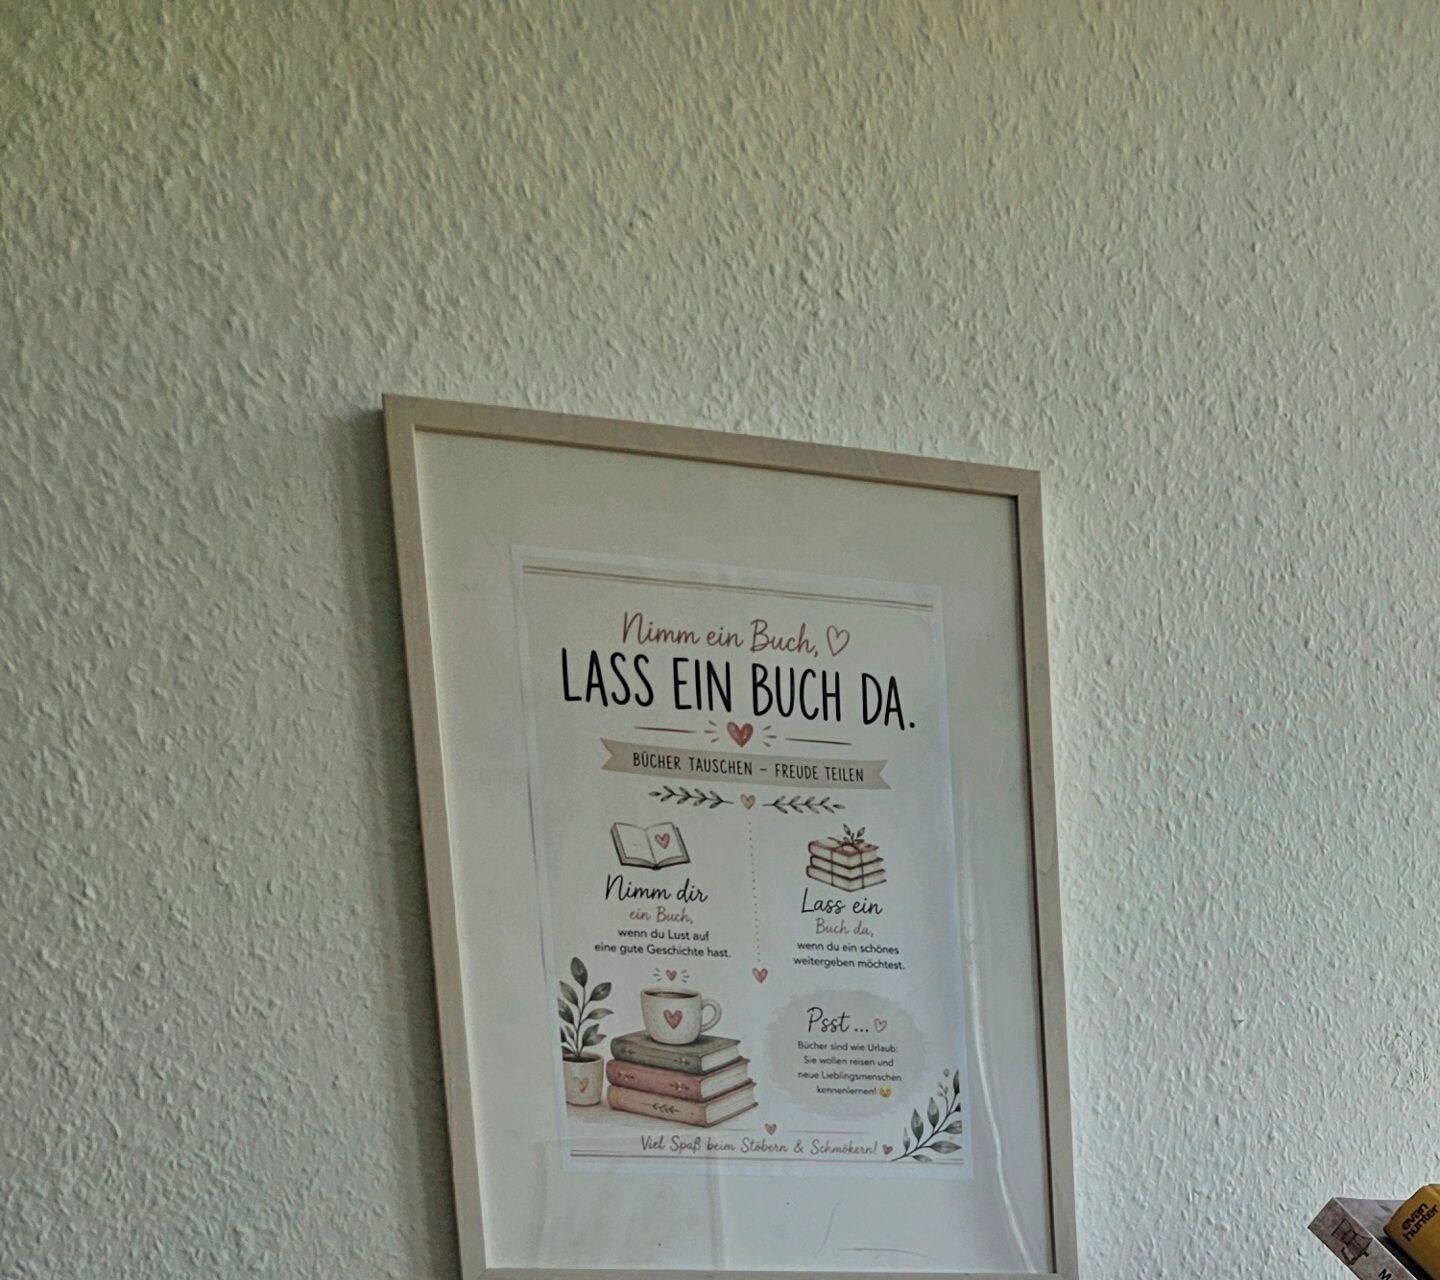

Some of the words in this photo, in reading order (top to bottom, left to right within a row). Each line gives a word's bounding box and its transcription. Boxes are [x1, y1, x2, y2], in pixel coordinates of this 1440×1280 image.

[623, 612, 700, 645] Nimm
[707, 626, 744, 648] ein
[750, 619, 818, 657] Buch,
[561, 648, 654, 707] LASS
[674, 657, 732, 713] EIN
[753, 663, 840, 722] BUCH
[861, 672, 915, 730] DA.
[633, 752, 681, 770] BÜCHER
[688, 757, 753, 775] TAUSCHEN
[775, 764, 818, 780] FREUDE
[824, 767, 863, 782] TEILEN
[605, 874, 670, 901] Nimm
[677, 878, 708, 903] dir
[801, 887, 845, 914] Lass
[853, 898, 883, 914] ein
[630, 908, 650, 920] ein
[656, 906, 693, 924] Buch,
[618, 929, 647, 937] wenn
[651, 928, 664, 939] du
[668, 930, 689, 940] Lust
[693, 931, 709, 940] auf
[815, 918, 849, 934] Buch
[854, 920, 874, 937] da,
[595, 943, 616, 951] eine
[620, 945, 643, 955] gute
[647, 944, 704, 956] Geschichte
[707, 947, 731, 957] hast.
[827, 942, 839, 951] du
[843, 943, 857, 952] ein
[860, 944, 899, 954] schönes
[793, 956, 854, 968] weitergeben
[858, 958, 905, 970] möchtest.
[798, 1041, 827, 1050] Bücher
[830, 1042, 848, 1051] sind
[851, 1043, 865, 1051] wie
[804, 1056, 817, 1064] Sie
[819, 1056, 847, 1065] wollen
[850, 1057, 875, 1066] reisen
[878, 1058, 894, 1067] und
[798, 1071, 819, 1079] neue
[821, 1071, 902, 1082] Lieblingsmenschen
[817, 1086, 876, 1095] kennenlernen!
[640, 1136, 664, 1150] Viel
[670, 1136, 700, 1155] Spaß
[707, 1136, 736, 1150] beim
[741, 1136, 787, 1152] Stöbern
[810, 1140, 878, 1155] Schmökern!
